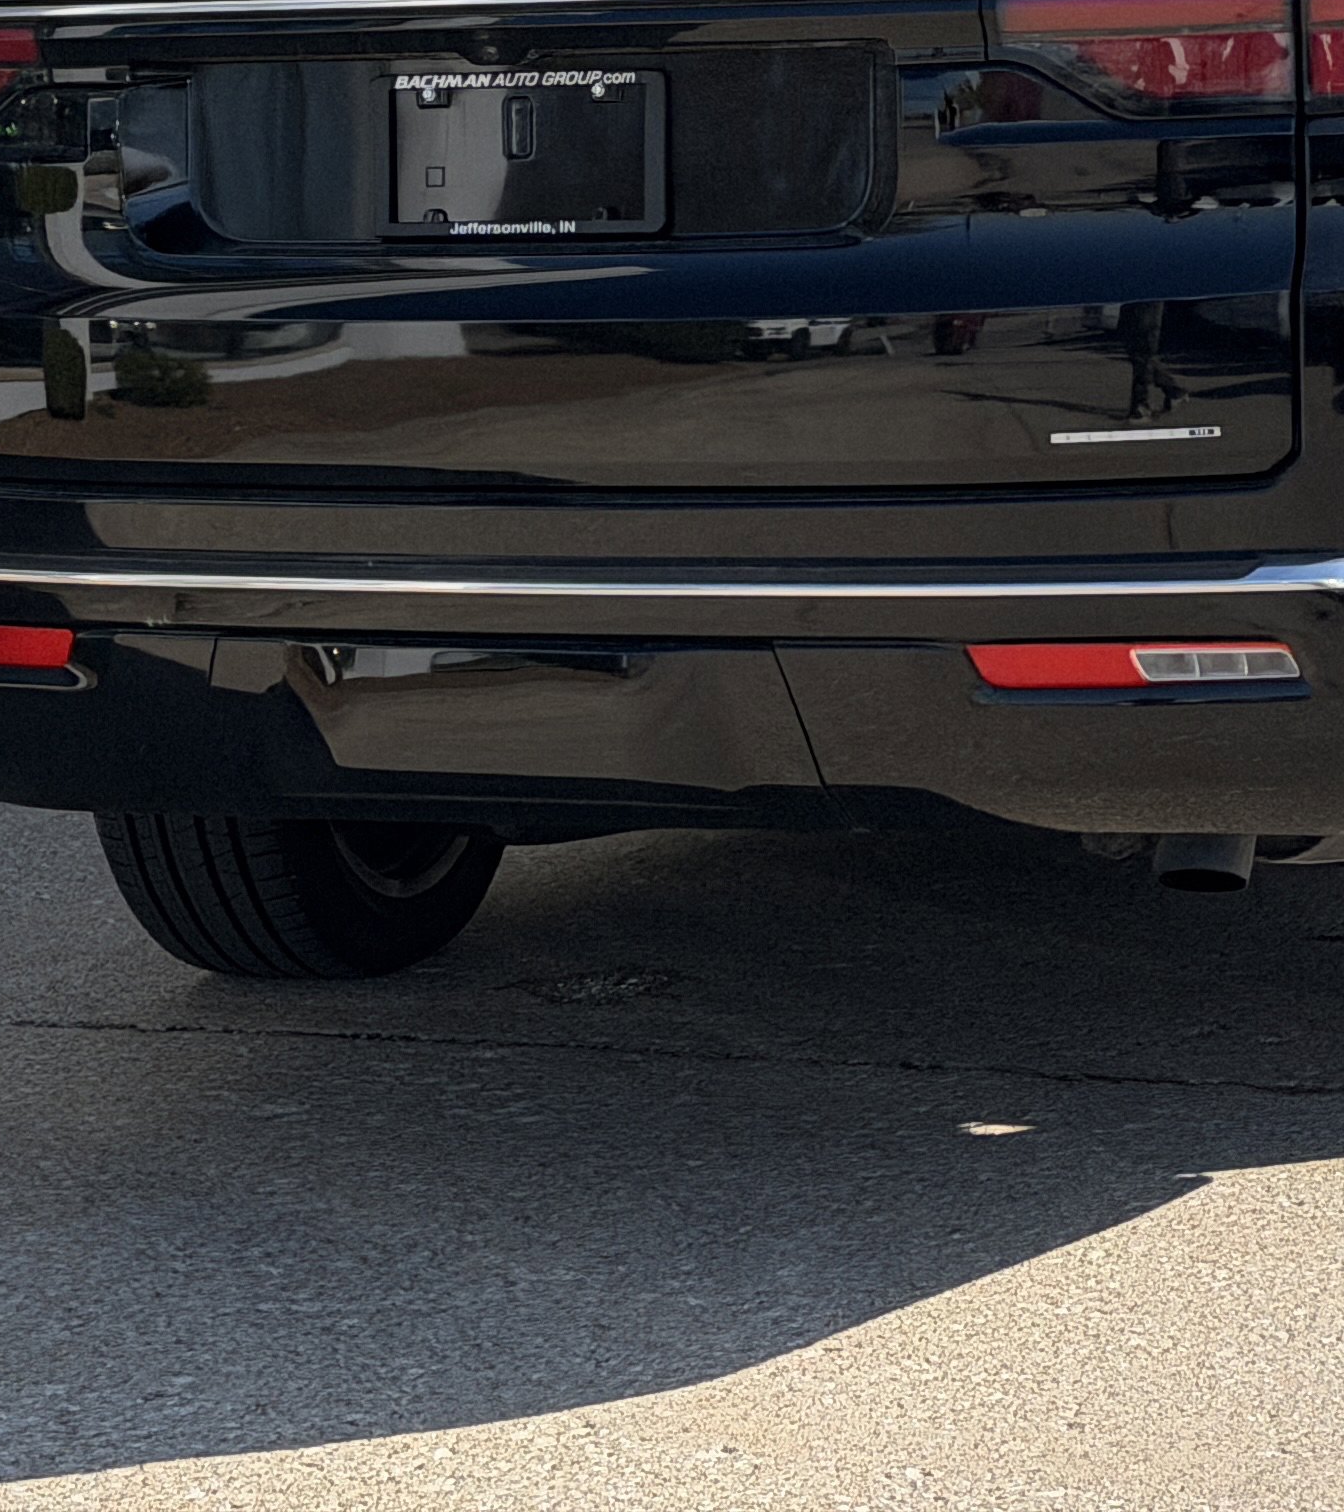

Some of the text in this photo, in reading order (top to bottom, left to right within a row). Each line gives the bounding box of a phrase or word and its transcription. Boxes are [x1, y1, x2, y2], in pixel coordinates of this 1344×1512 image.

[394, 74, 492, 89] BACHMAN
[492, 72, 539, 87] AUTO
[559, 220, 576, 233] IN
